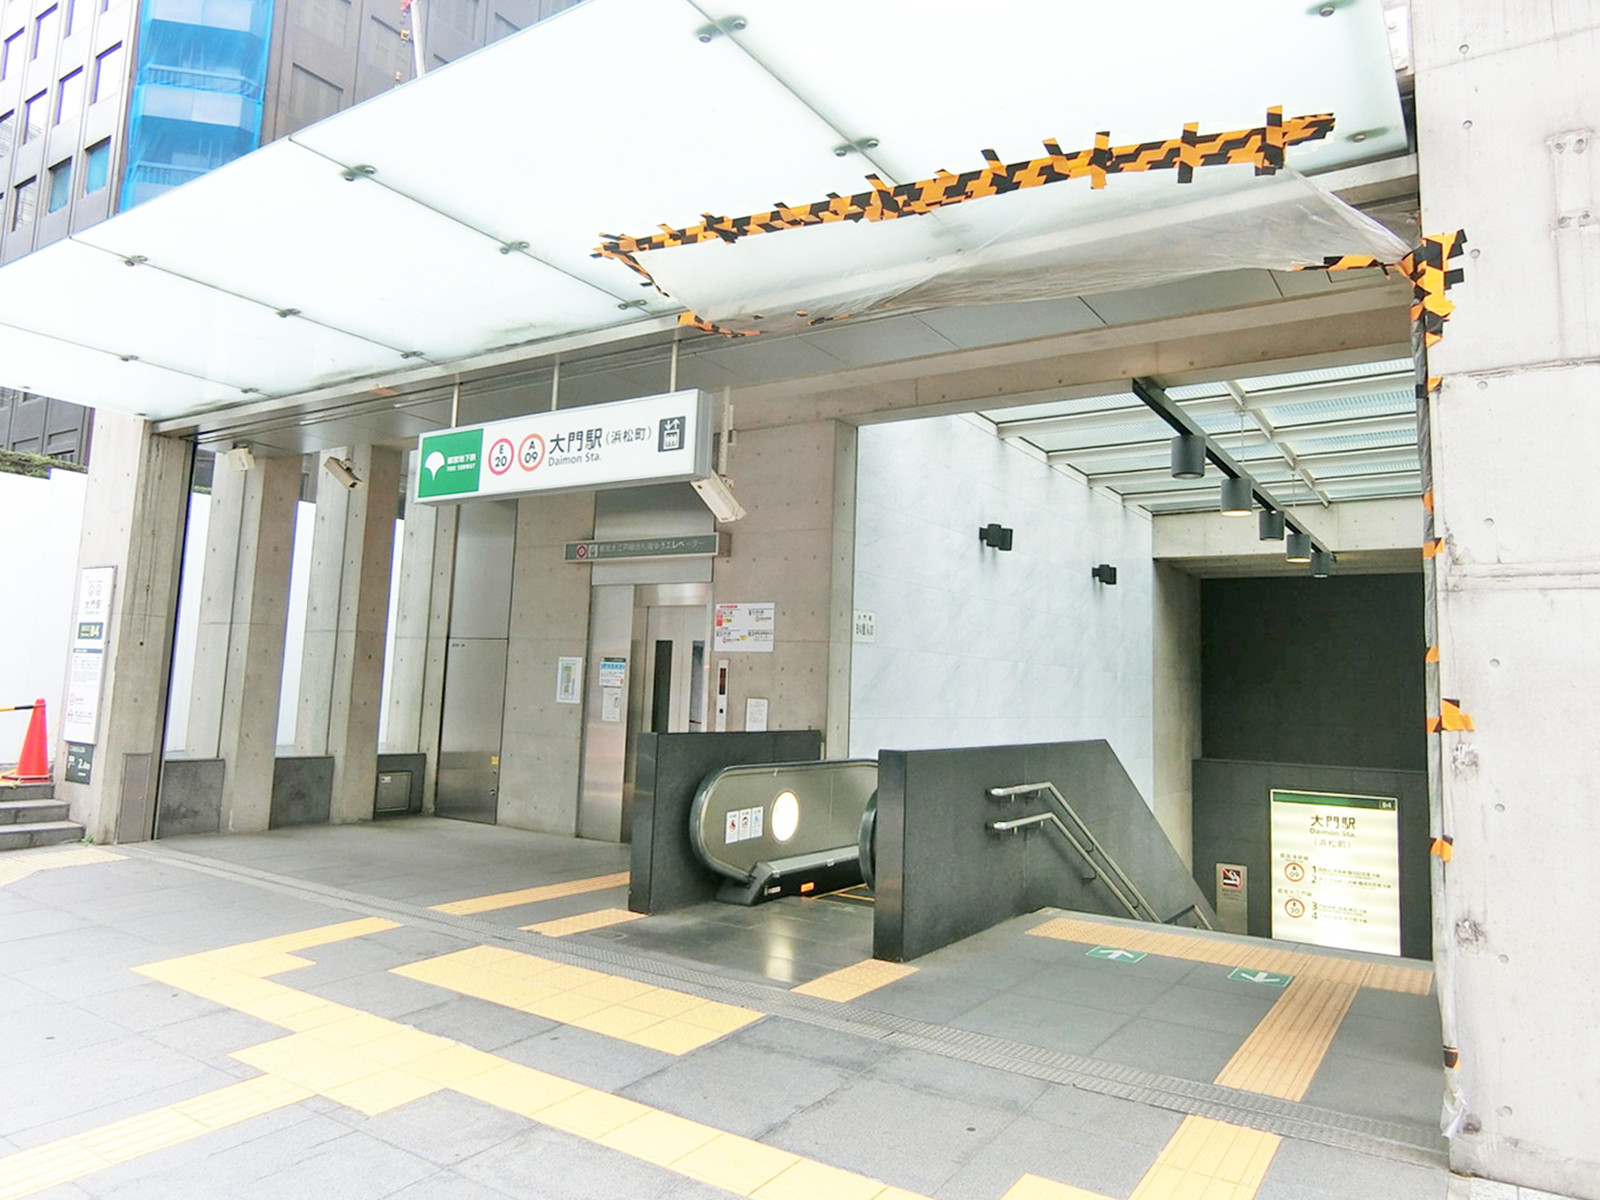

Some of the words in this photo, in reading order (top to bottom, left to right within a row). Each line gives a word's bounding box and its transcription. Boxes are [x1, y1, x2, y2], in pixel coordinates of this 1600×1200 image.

[529, 440, 536, 450] A
[548, 427, 603, 454] 大門駅
[499, 444, 505, 454] E
[494, 456, 508, 467] 20
[524, 451, 539, 464] 09
[547, 453, 583, 467] Daimon
[584, 451, 603, 462] Sta.
[1310, 814, 1356, 830] 大門駅
[1309, 828, 1340, 837] Daimon
[1311, 875, 1317, 884] 2
[1311, 901, 1318, 911] 3
